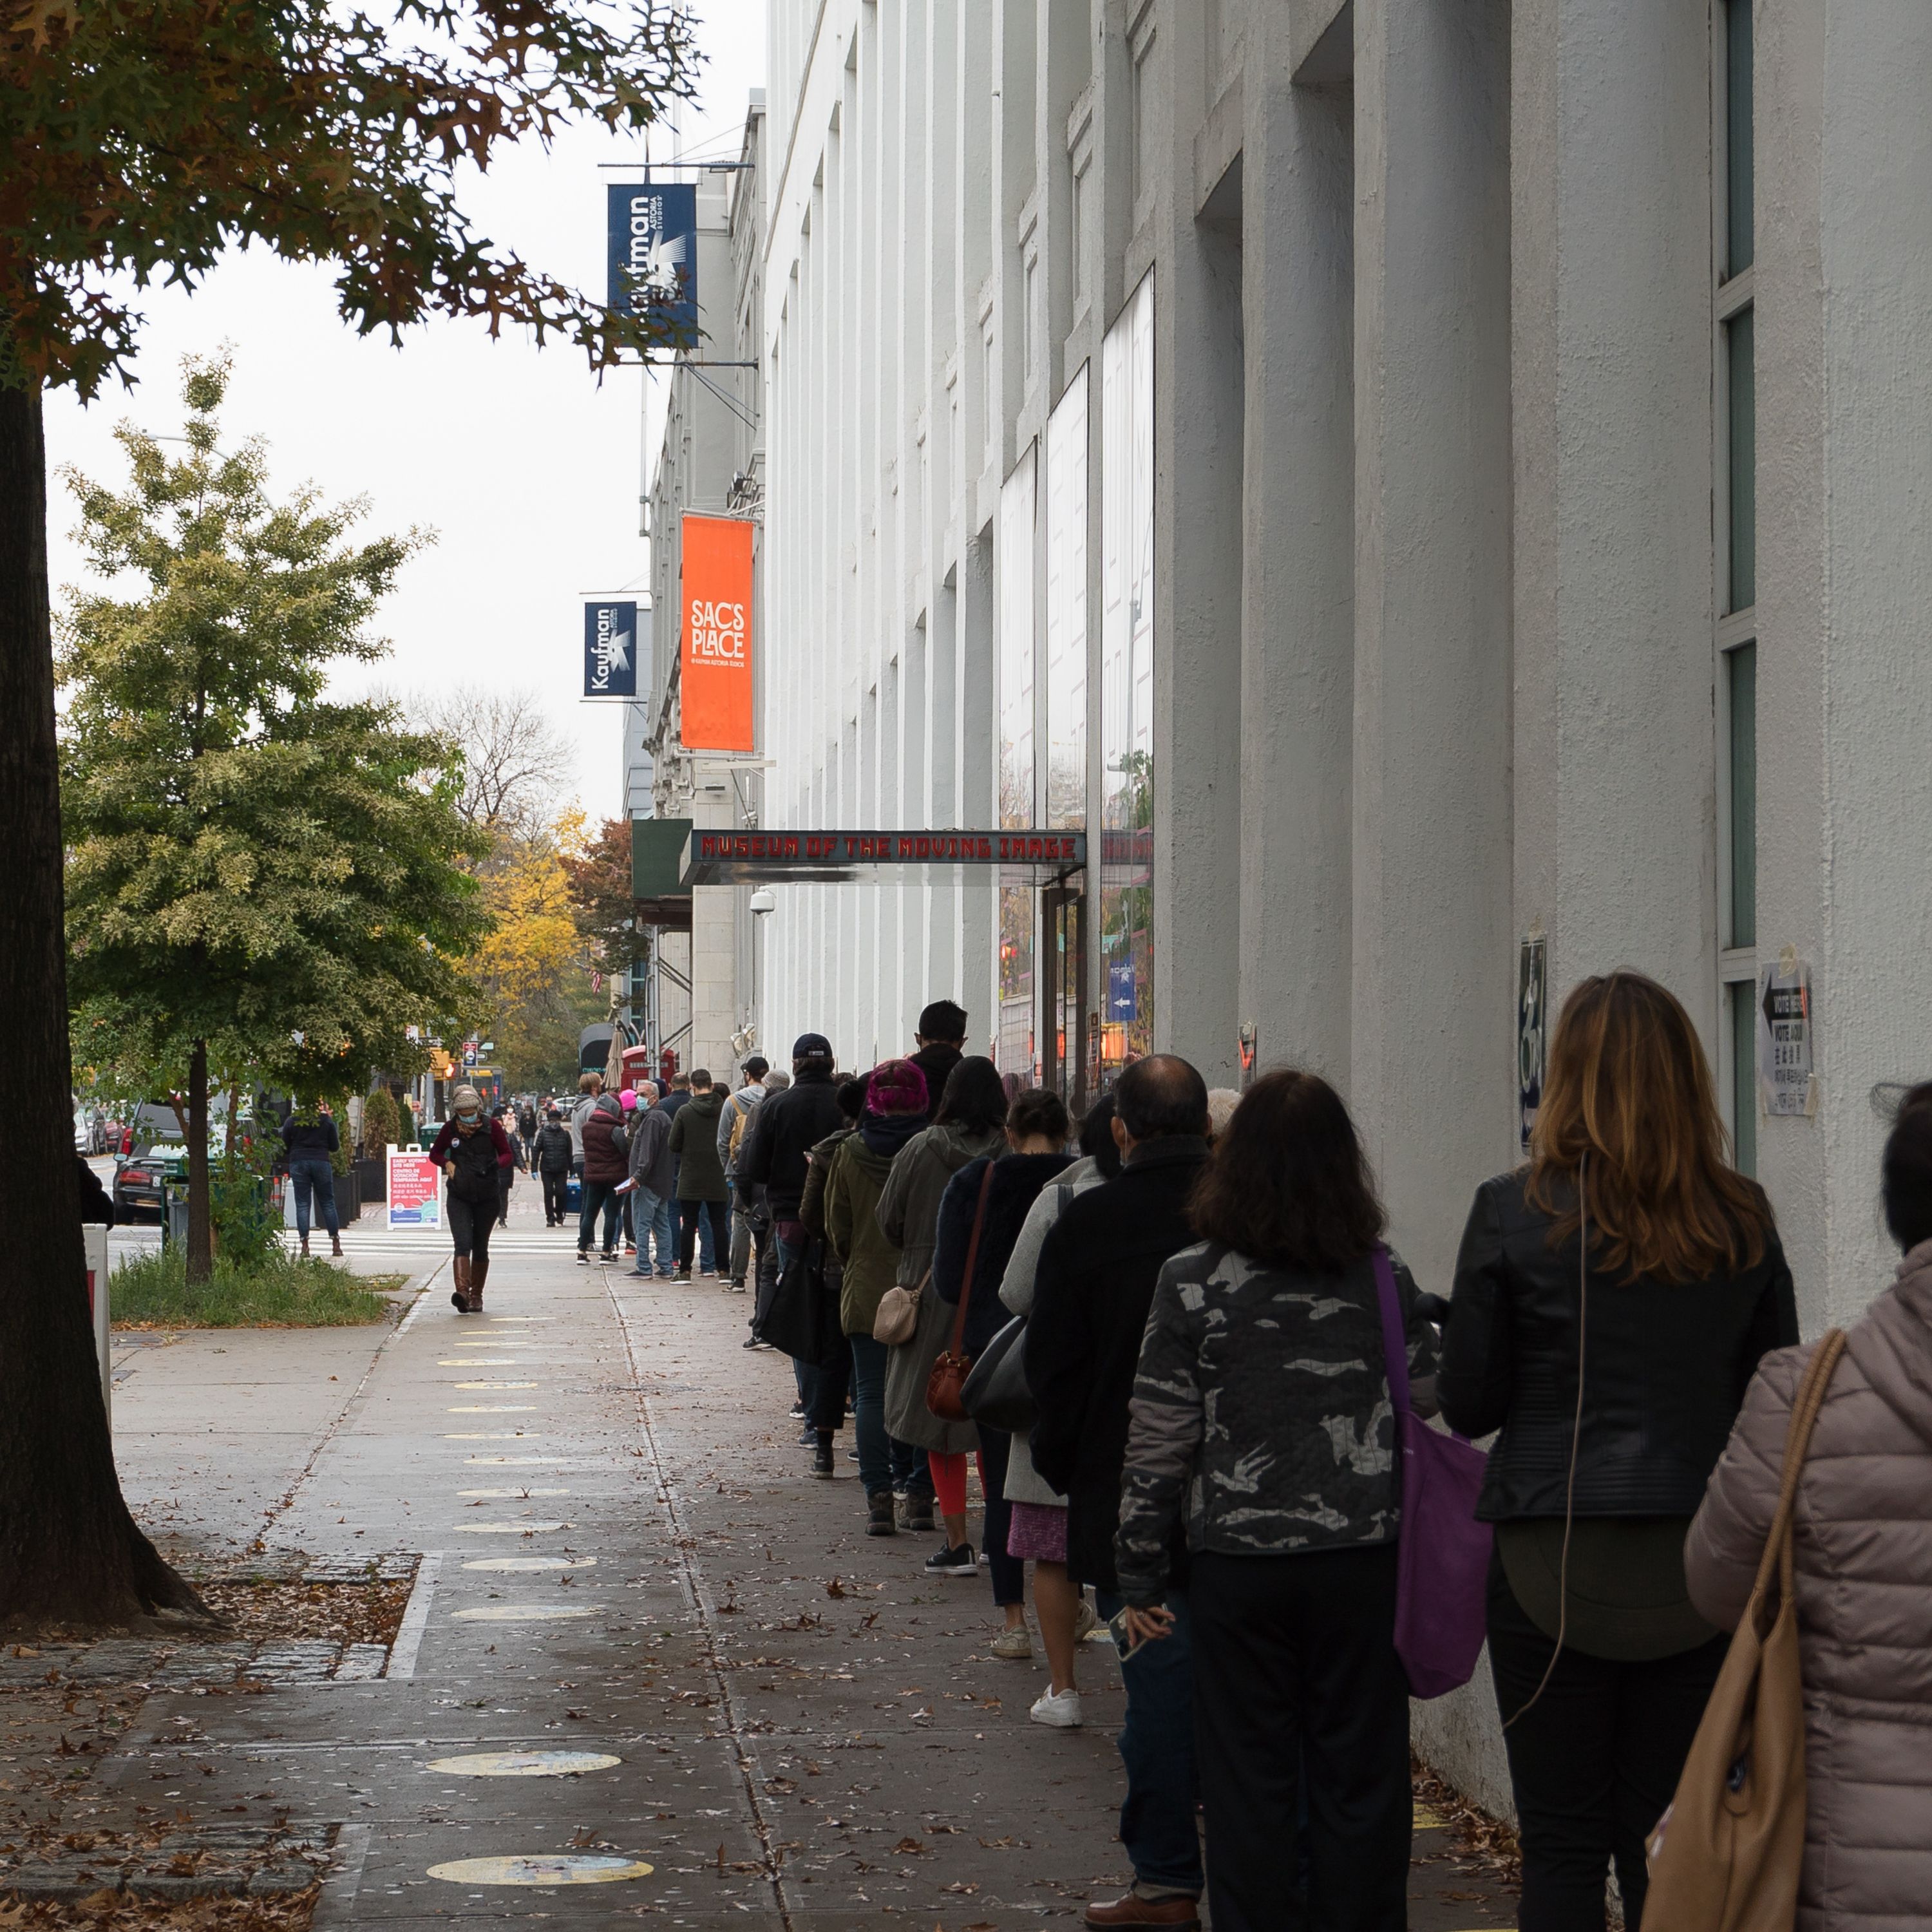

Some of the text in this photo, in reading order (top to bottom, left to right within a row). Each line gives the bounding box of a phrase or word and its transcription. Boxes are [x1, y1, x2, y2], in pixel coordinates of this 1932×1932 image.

[691, 599, 744, 631] SAC'S
[591, 609, 609, 689] Kaufman
[692, 629, 744, 658] PLACE
[701, 836, 1075, 858] MUSEUM OF THE MOVING IMAGE
[1774, 995, 1789, 1014] VOTE
[1774, 1024, 1789, 1042] VOTE
